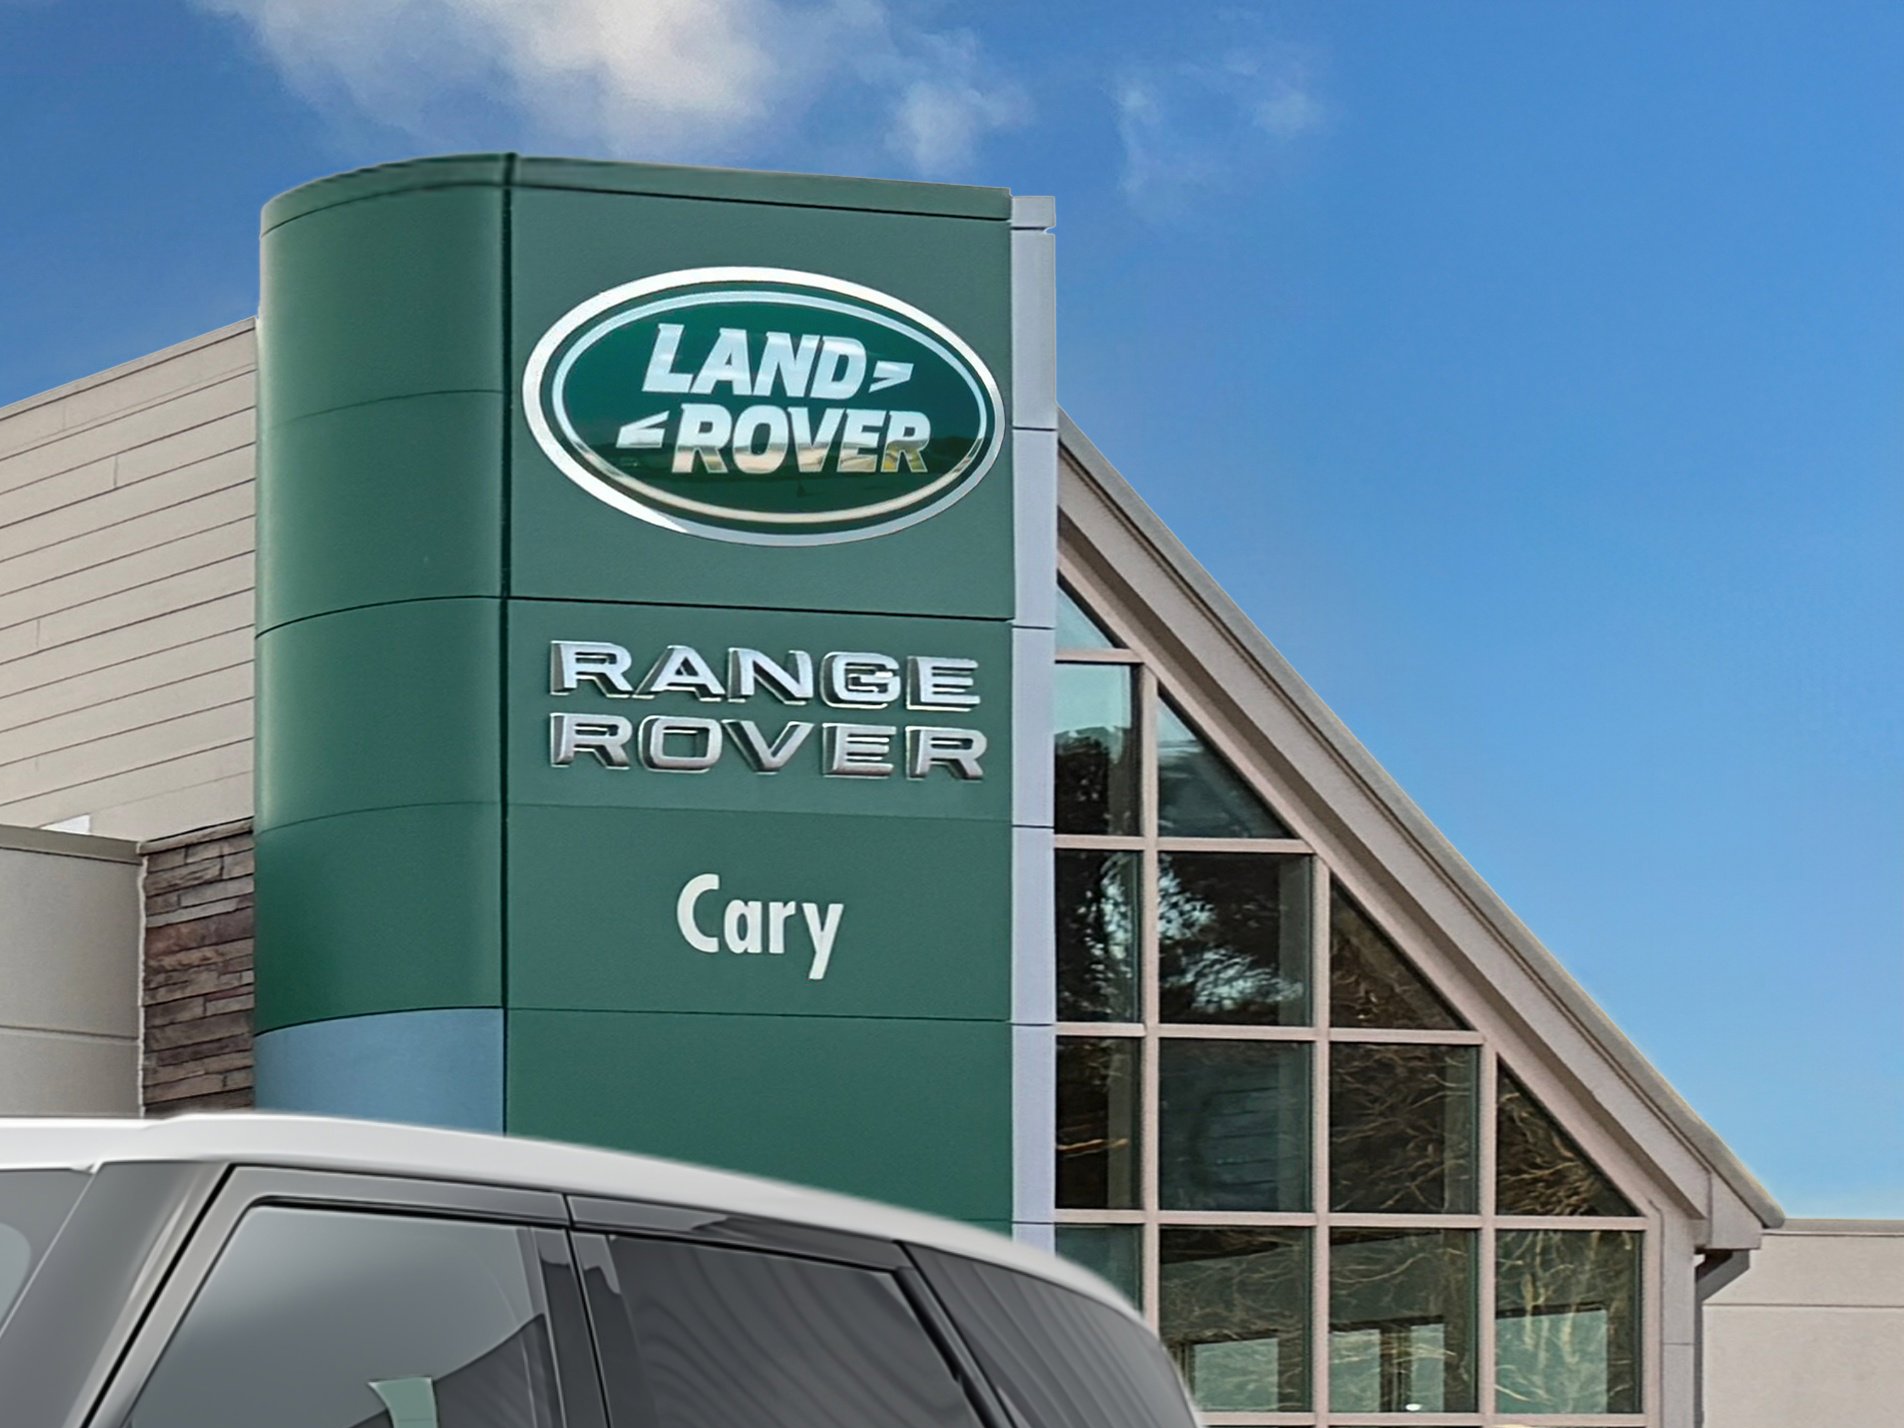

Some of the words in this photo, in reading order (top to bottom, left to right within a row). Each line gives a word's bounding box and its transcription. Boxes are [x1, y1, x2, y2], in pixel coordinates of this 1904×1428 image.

[640, 322, 870, 401] LAND
[670, 404, 932, 475] ROVER
[549, 639, 982, 710] RANGE
[549, 711, 989, 781] ROVER
[676, 872, 845, 981] Cary
